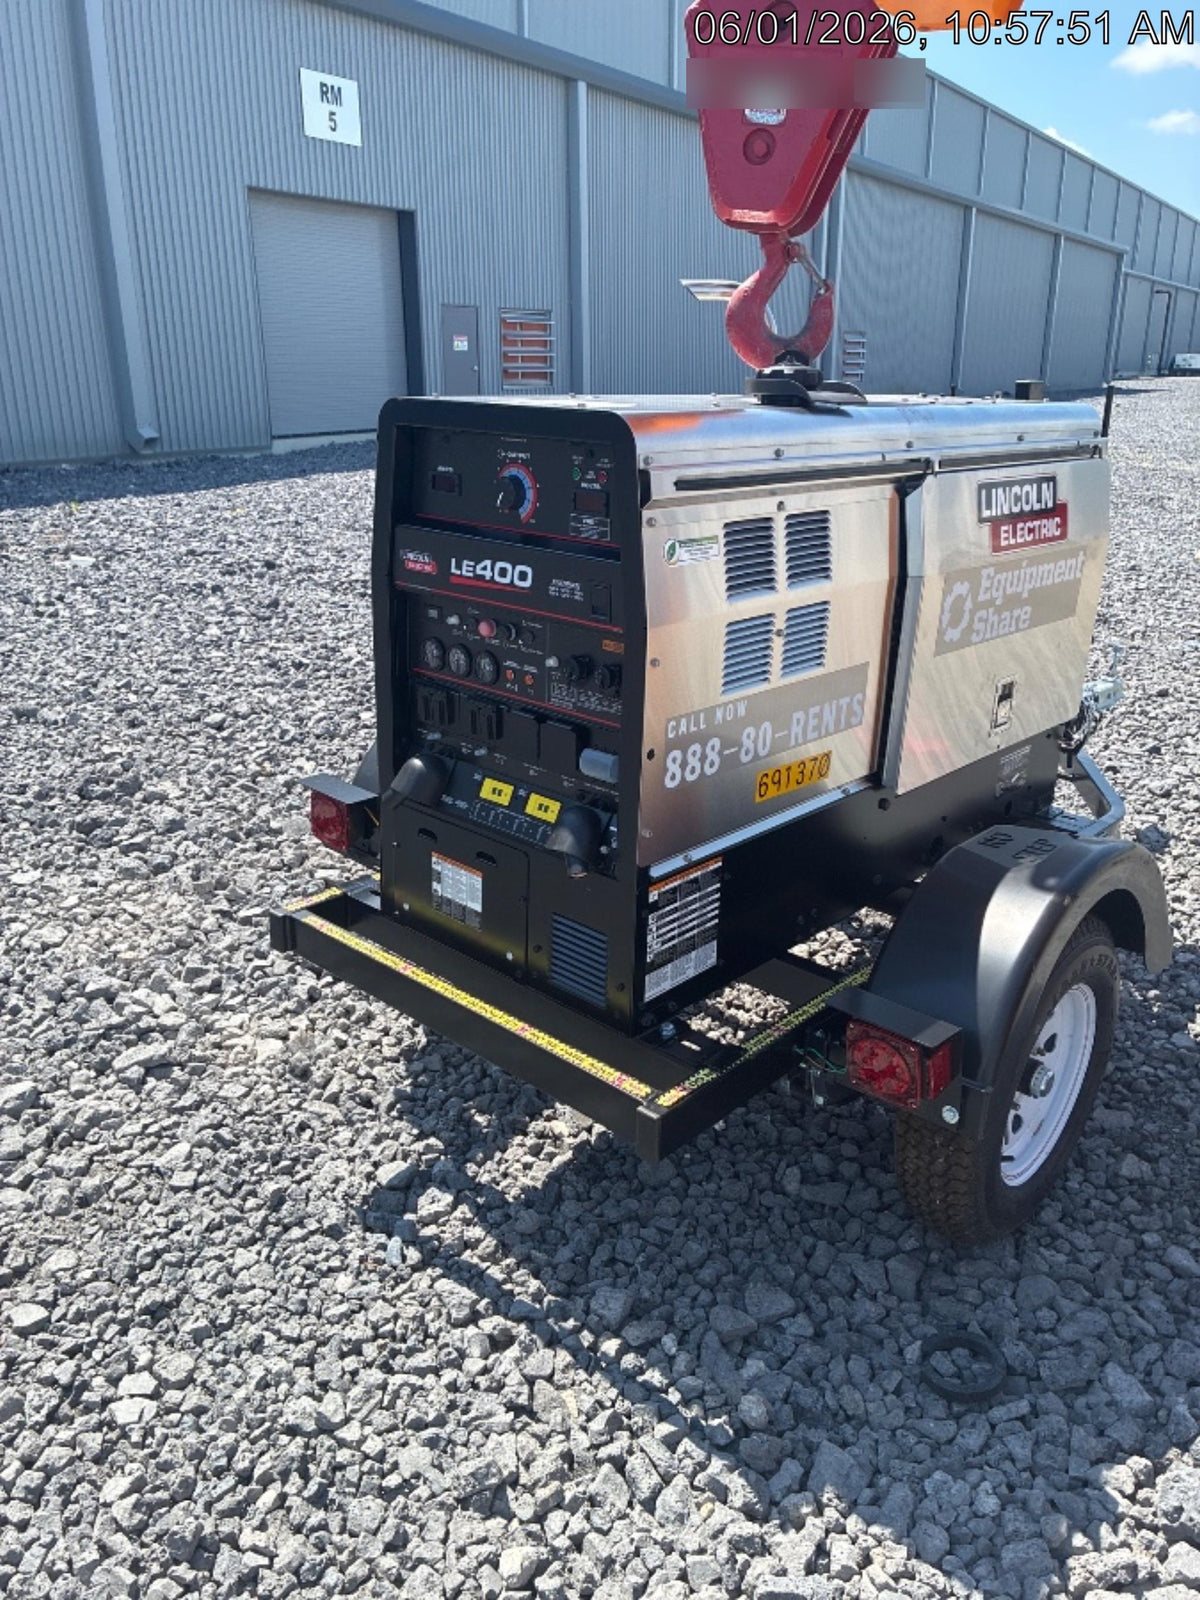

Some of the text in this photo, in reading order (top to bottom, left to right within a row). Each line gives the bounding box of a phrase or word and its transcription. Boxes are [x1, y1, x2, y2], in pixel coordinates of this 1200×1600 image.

[319, 82, 343, 107] RM
[328, 111, 337, 132] 5
[981, 481, 1054, 518] LINCOLN
[1000, 517, 1061, 546] ELECTRIC
[450, 557, 533, 588] LE400
[977, 551, 1085, 605] Equipment
[970, 606, 1032, 643] Share
[667, 700, 748, 738] CALL NOW
[664, 692, 865, 789] 888-80-RENTS
[758, 752, 831, 798] 691370
